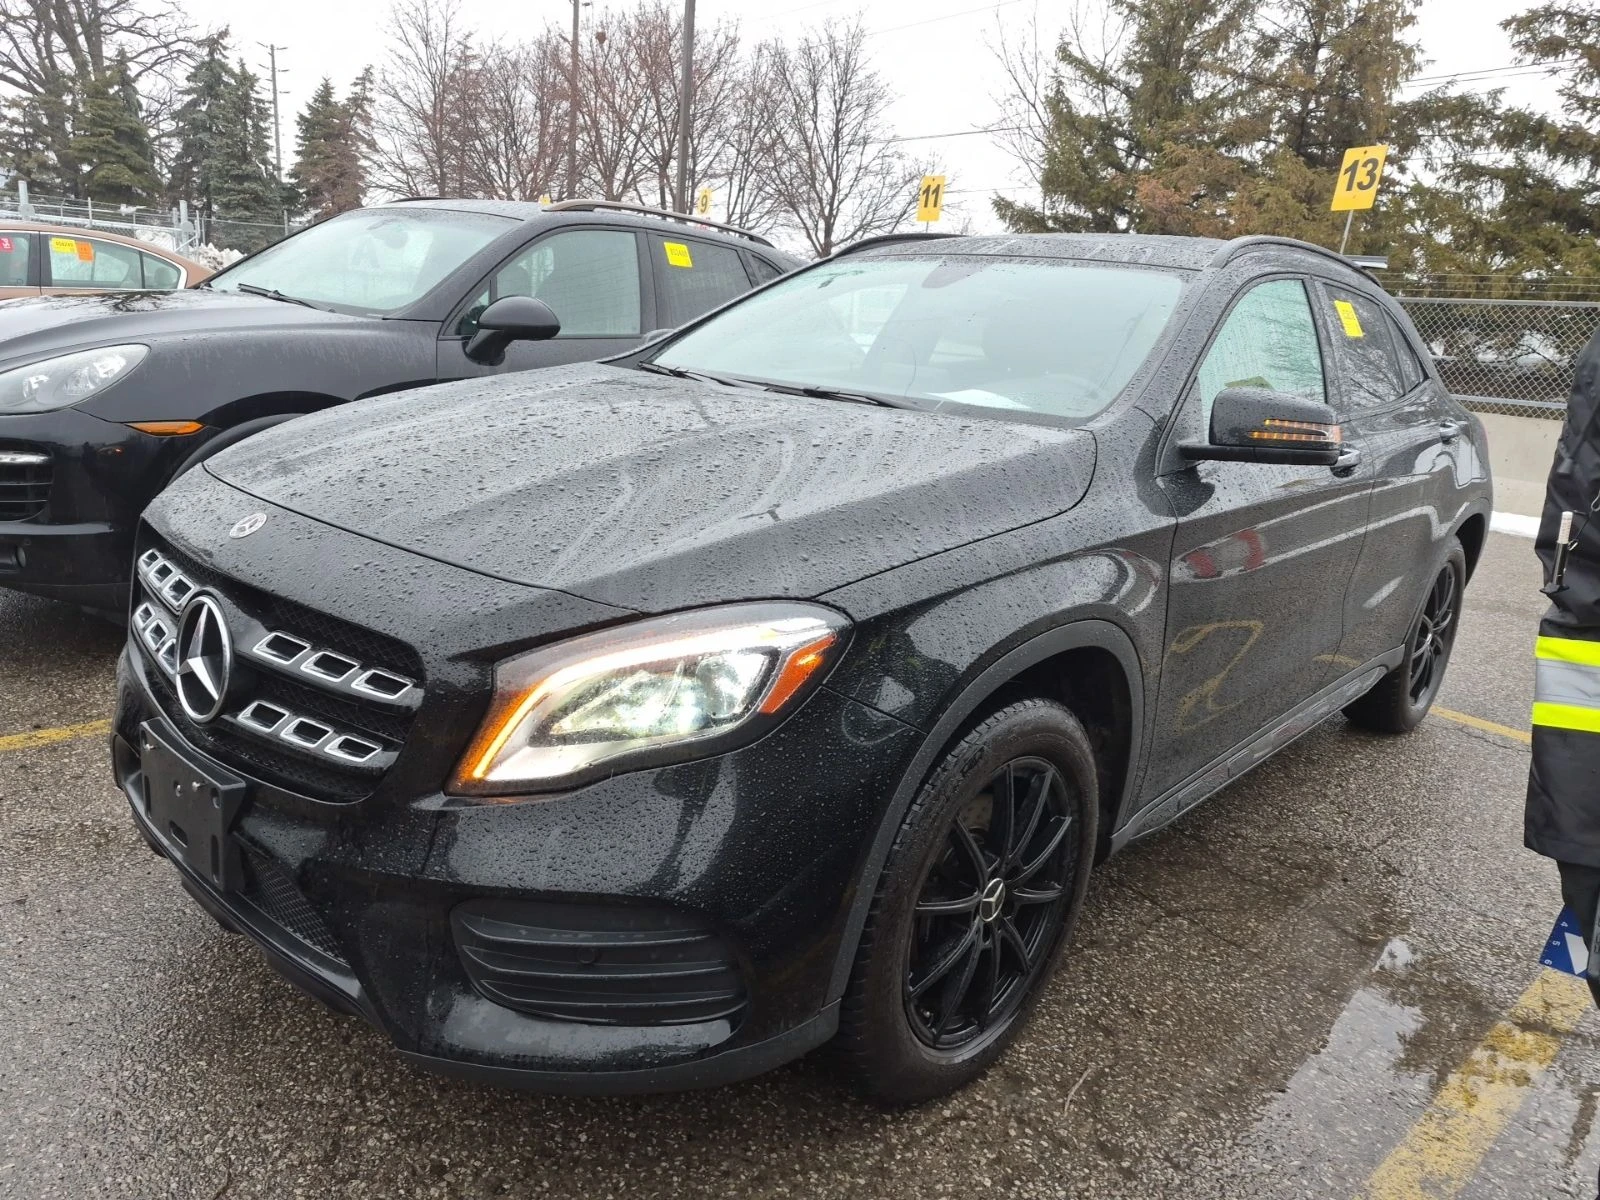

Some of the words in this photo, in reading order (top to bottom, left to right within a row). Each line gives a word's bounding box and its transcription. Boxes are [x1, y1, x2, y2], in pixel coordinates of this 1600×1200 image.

[1343, 157, 1379, 192] 13
[700, 194, 708, 213] 9
[922, 183, 941, 208] 11
